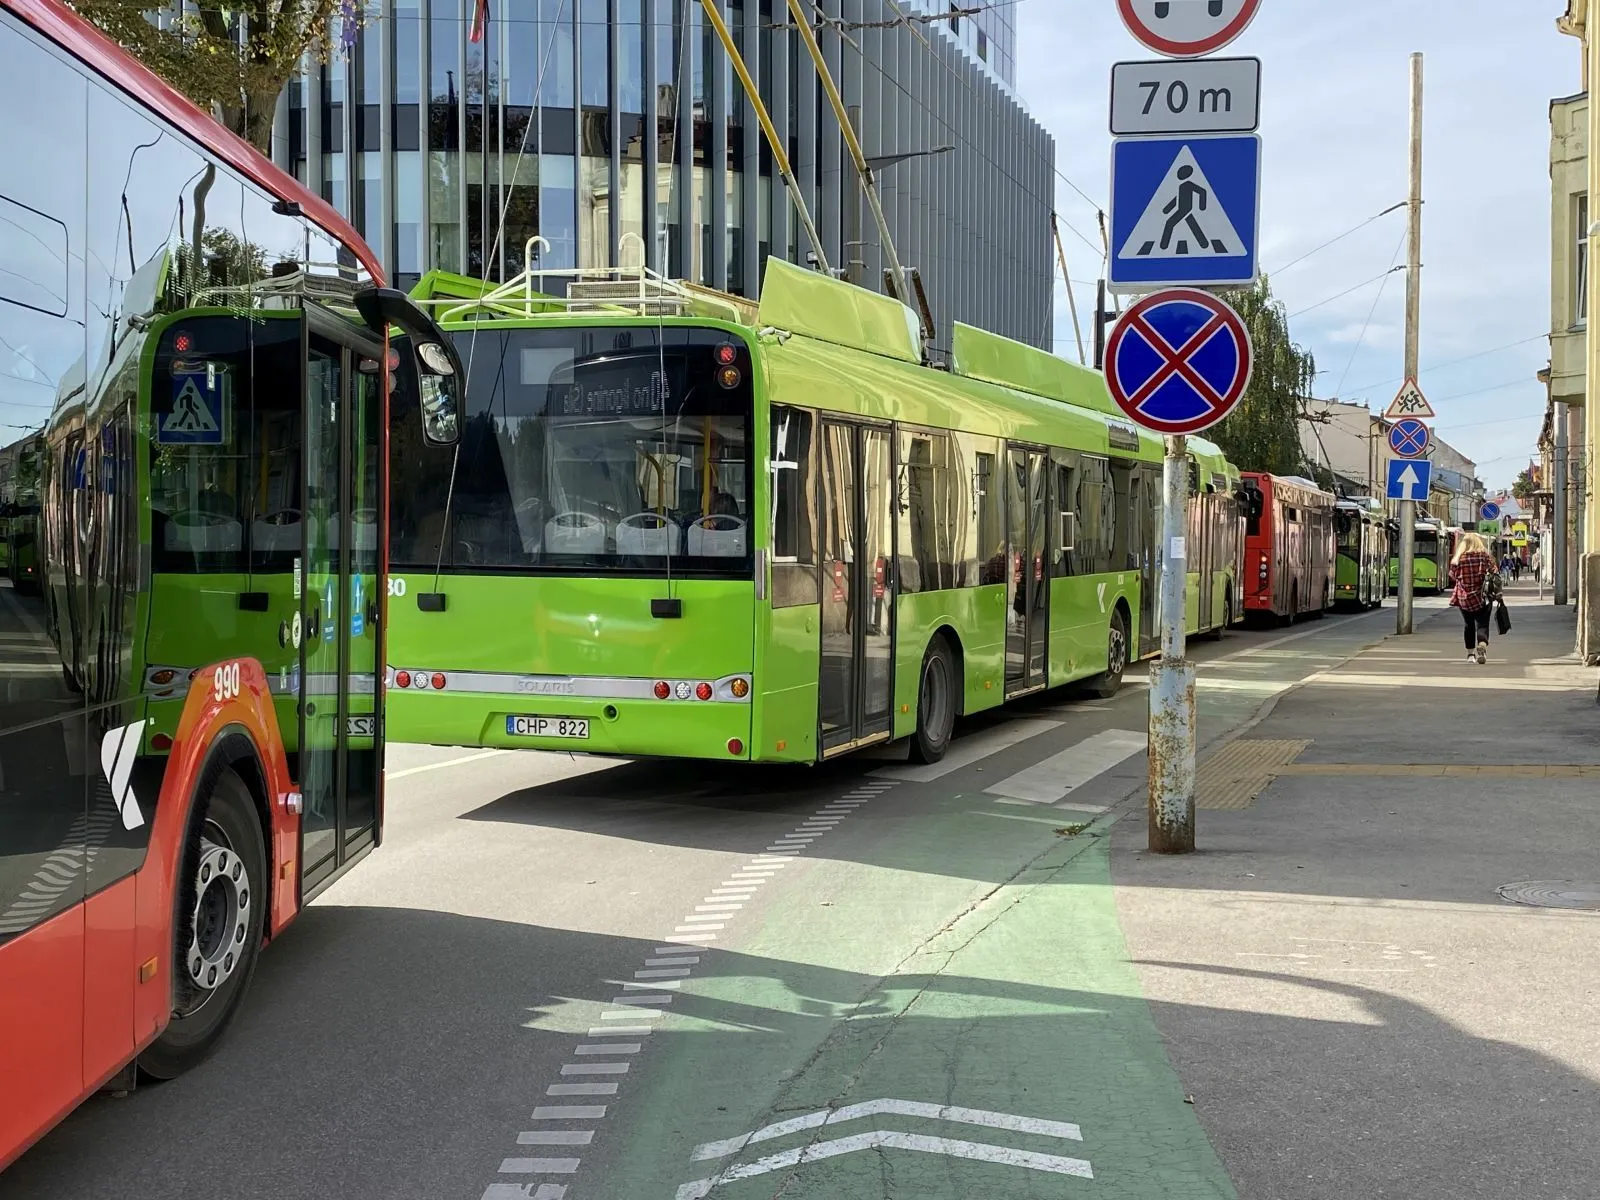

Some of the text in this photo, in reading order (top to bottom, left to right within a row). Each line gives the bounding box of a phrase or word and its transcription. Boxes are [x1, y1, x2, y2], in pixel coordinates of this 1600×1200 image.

[1139, 80, 1231, 115] 70 m
[214, 662, 240, 702] 990
[518, 680, 575, 694] SOLARIS
[516, 718, 587, 737] CHP 822
